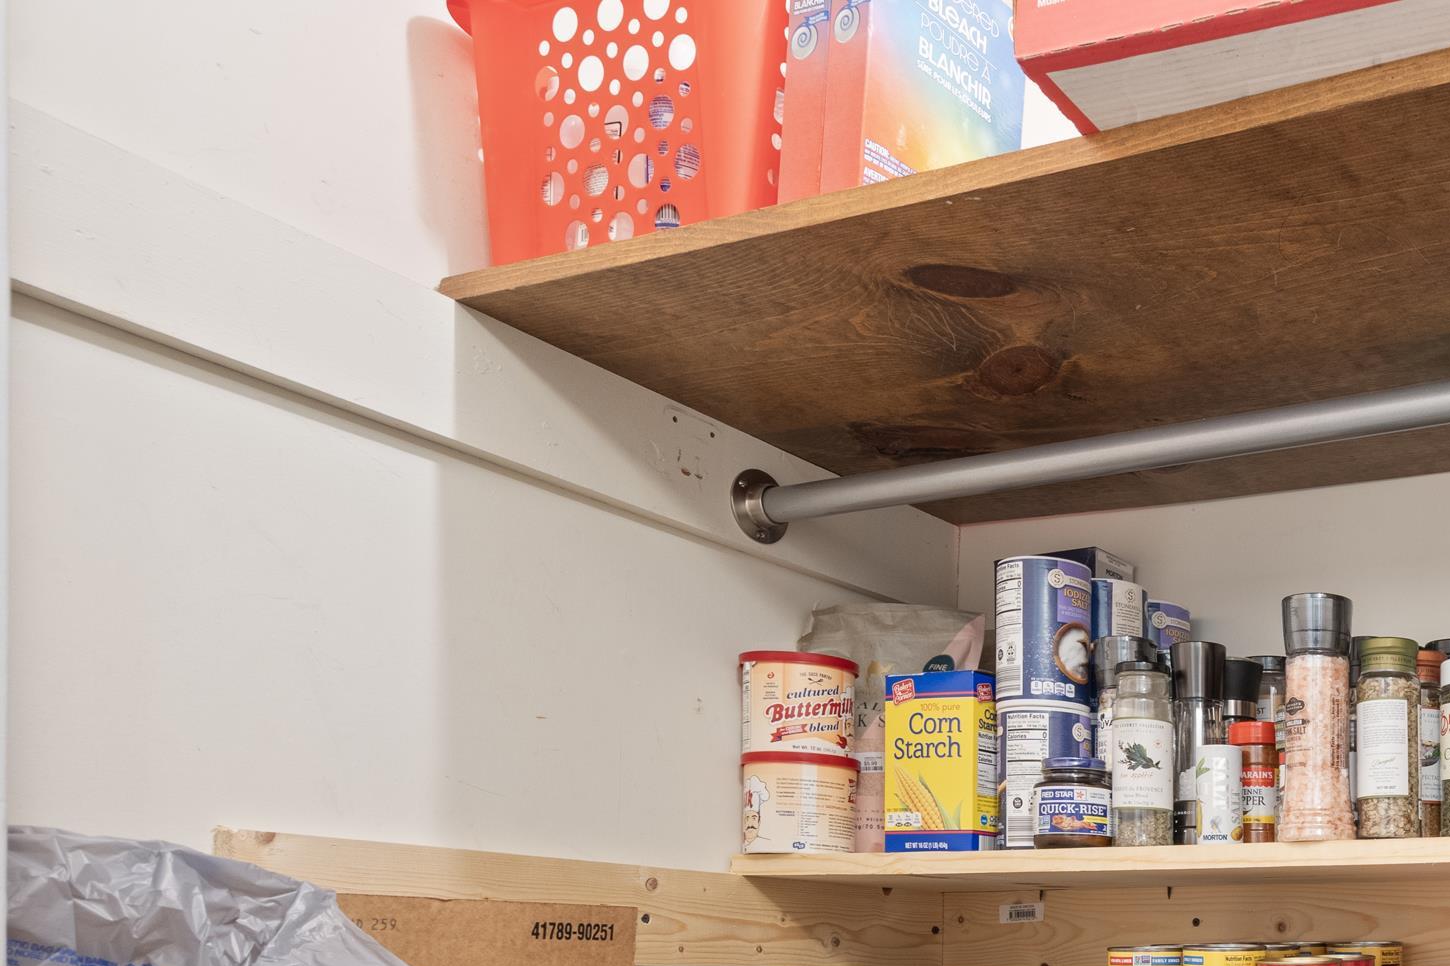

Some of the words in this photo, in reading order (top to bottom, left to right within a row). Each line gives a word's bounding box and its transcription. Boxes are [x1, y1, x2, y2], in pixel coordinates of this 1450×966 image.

[918, 36, 992, 110] BLANCHIR
[786, 687, 839, 700] cultured
[765, 697, 853, 725] Buttermilk
[808, 722, 839, 733] blend
[909, 712, 962, 736] Corn
[893, 735, 962, 761] Starch
[1041, 790, 1055, 799] RED
[1055, 790, 1074, 799] STAR
[1040, 804, 1104, 816] QUICK-RISE
[1202, 834, 1228, 842] MORTON
[531, 921, 615, 942] 41789-90251
